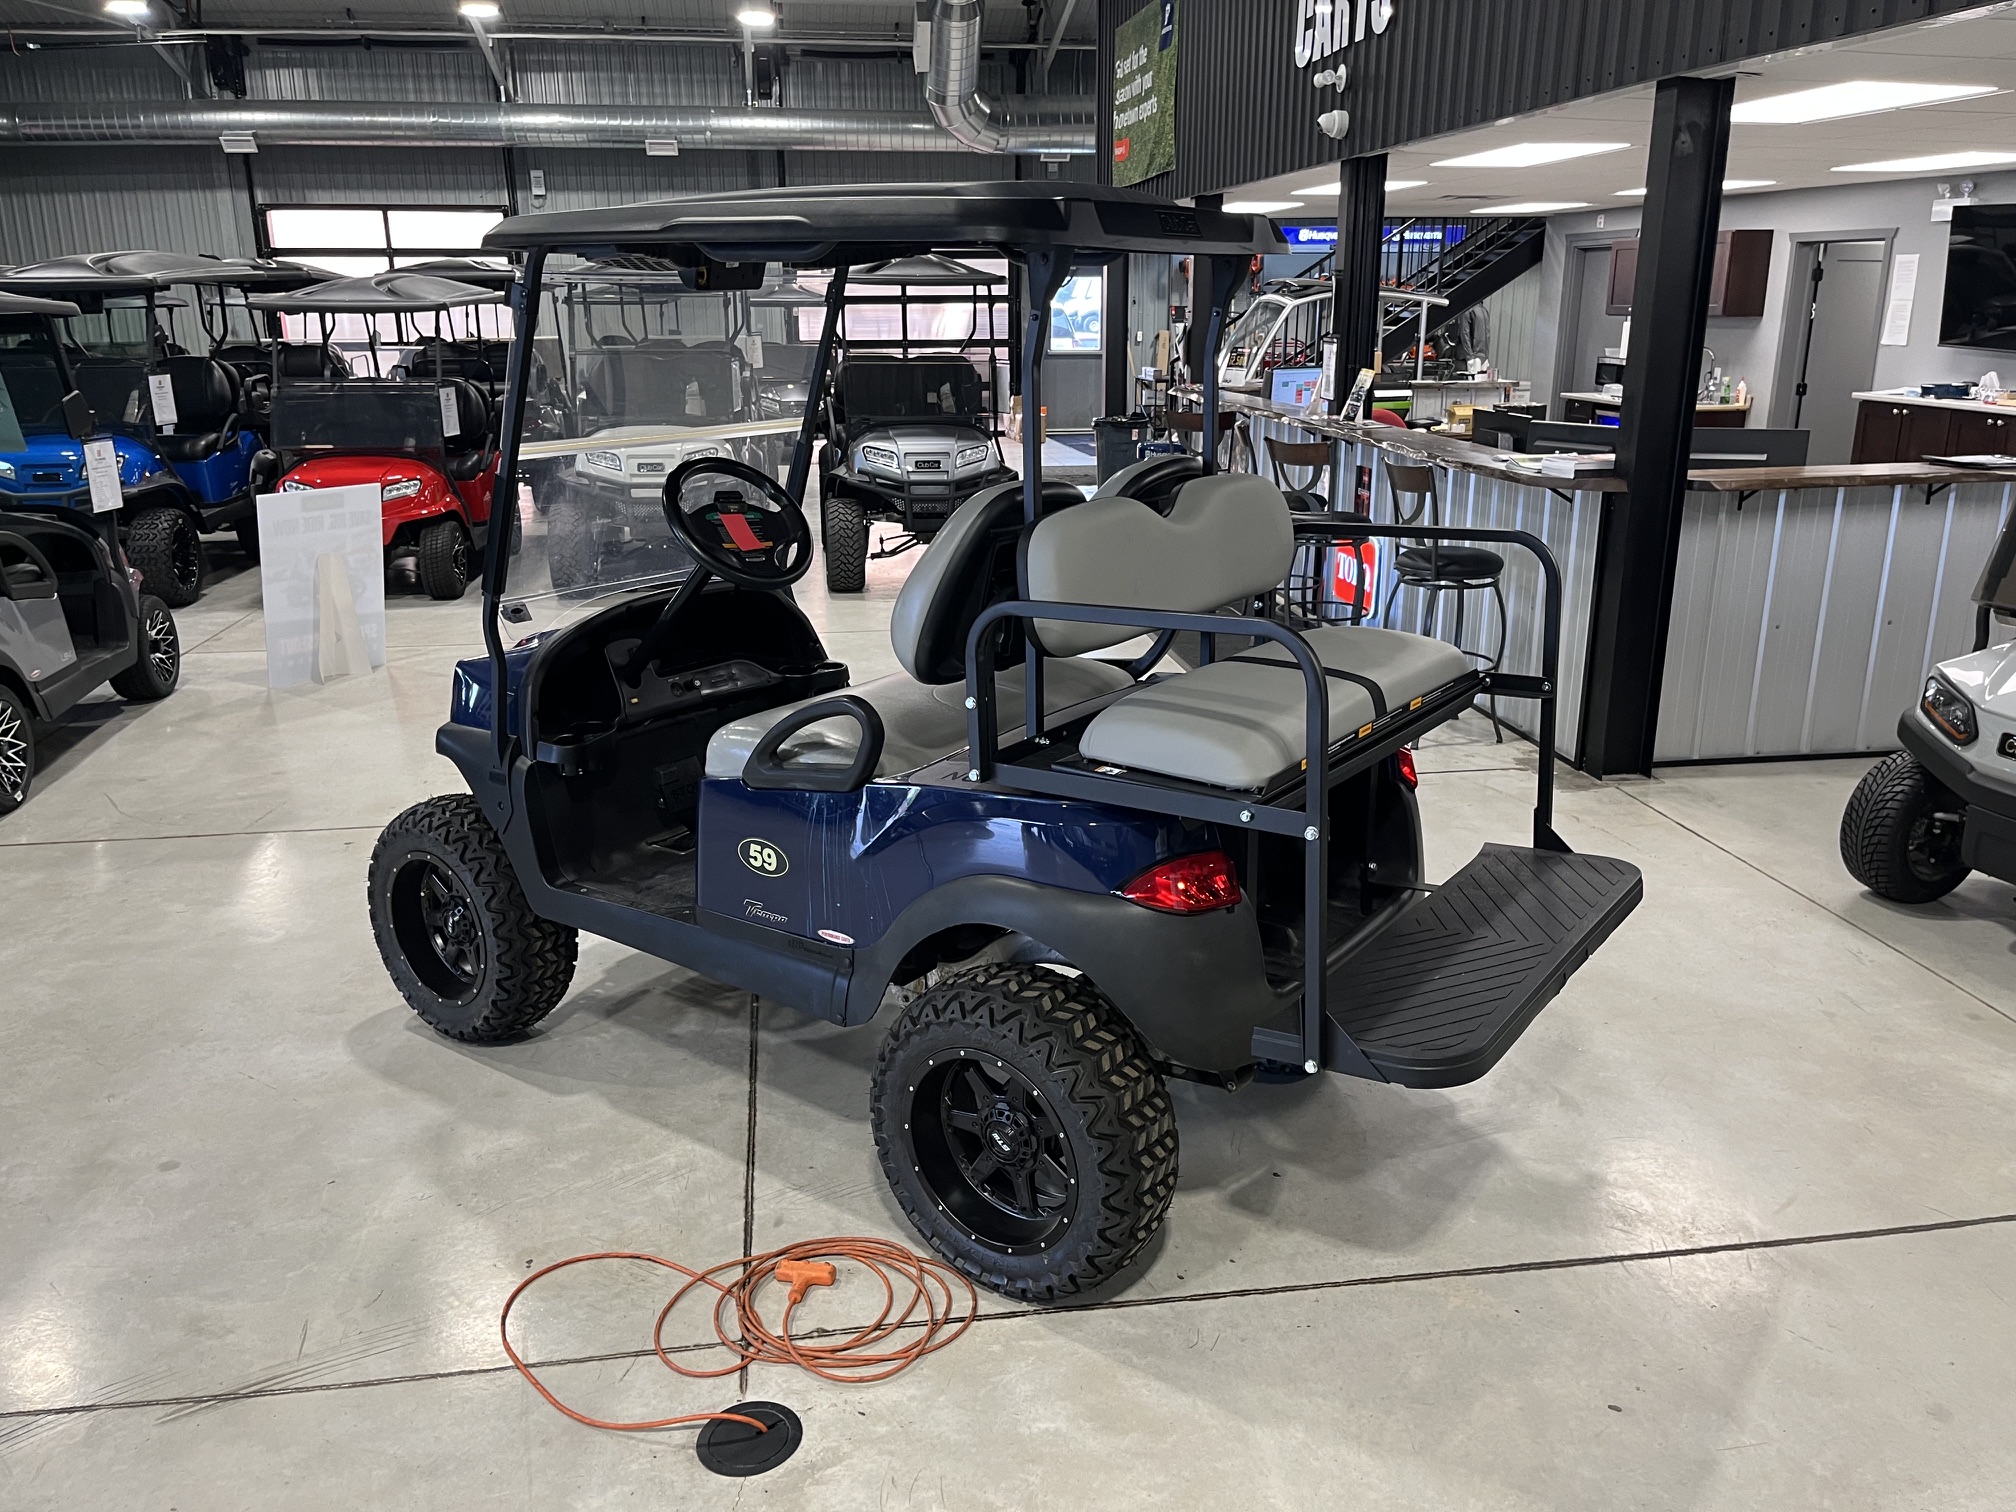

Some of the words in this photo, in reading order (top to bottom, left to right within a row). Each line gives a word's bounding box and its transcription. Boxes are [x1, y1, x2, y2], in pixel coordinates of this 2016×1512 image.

[1138, 44, 1148, 67] the
[1138, 93, 1158, 123] experts
[1337, 551, 1371, 592] TOO
[749, 843, 777, 872] 59
[743, 898, 789, 923] Tempo
